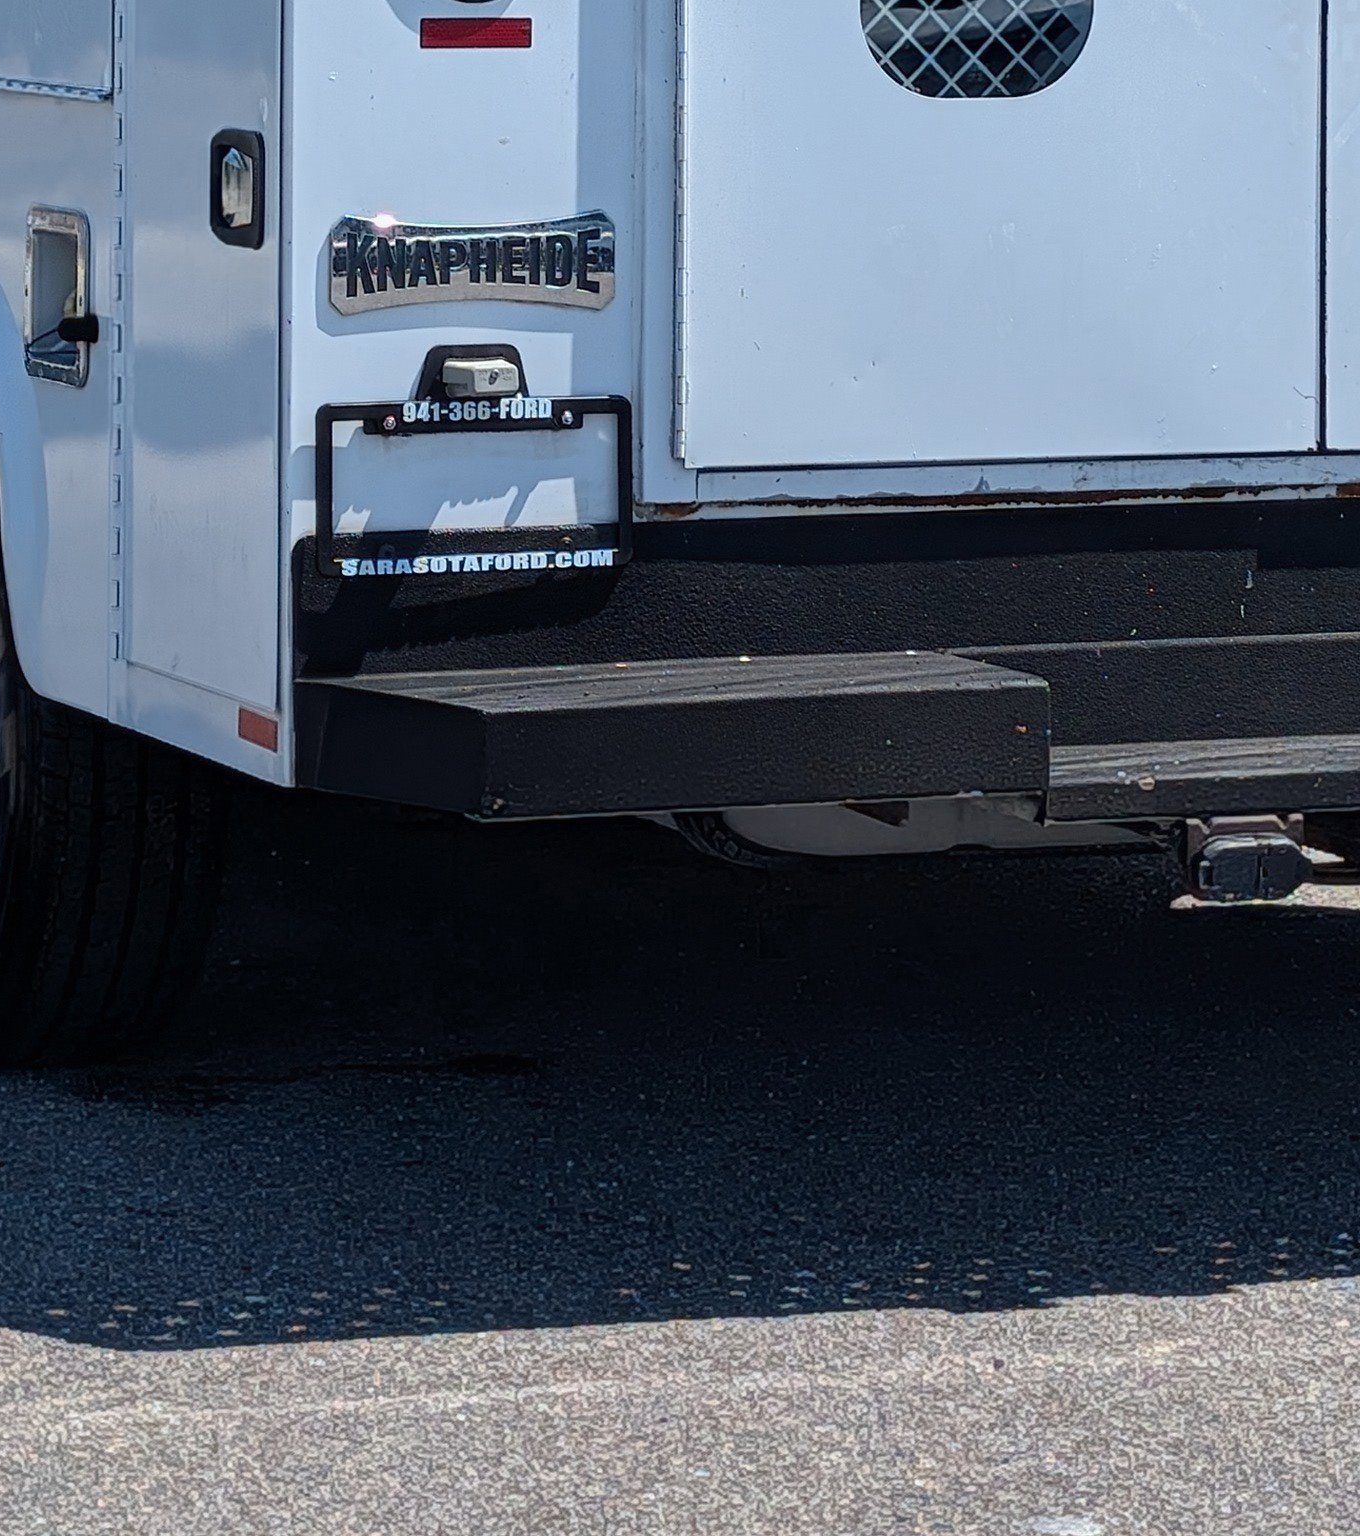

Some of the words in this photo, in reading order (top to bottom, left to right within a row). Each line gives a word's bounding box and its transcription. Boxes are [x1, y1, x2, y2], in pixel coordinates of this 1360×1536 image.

[345, 227, 602, 299] KNAPHEIDE
[402, 398, 552, 423] 941-366-FORD
[341, 549, 614, 577] SARASOTAFORD.COM
